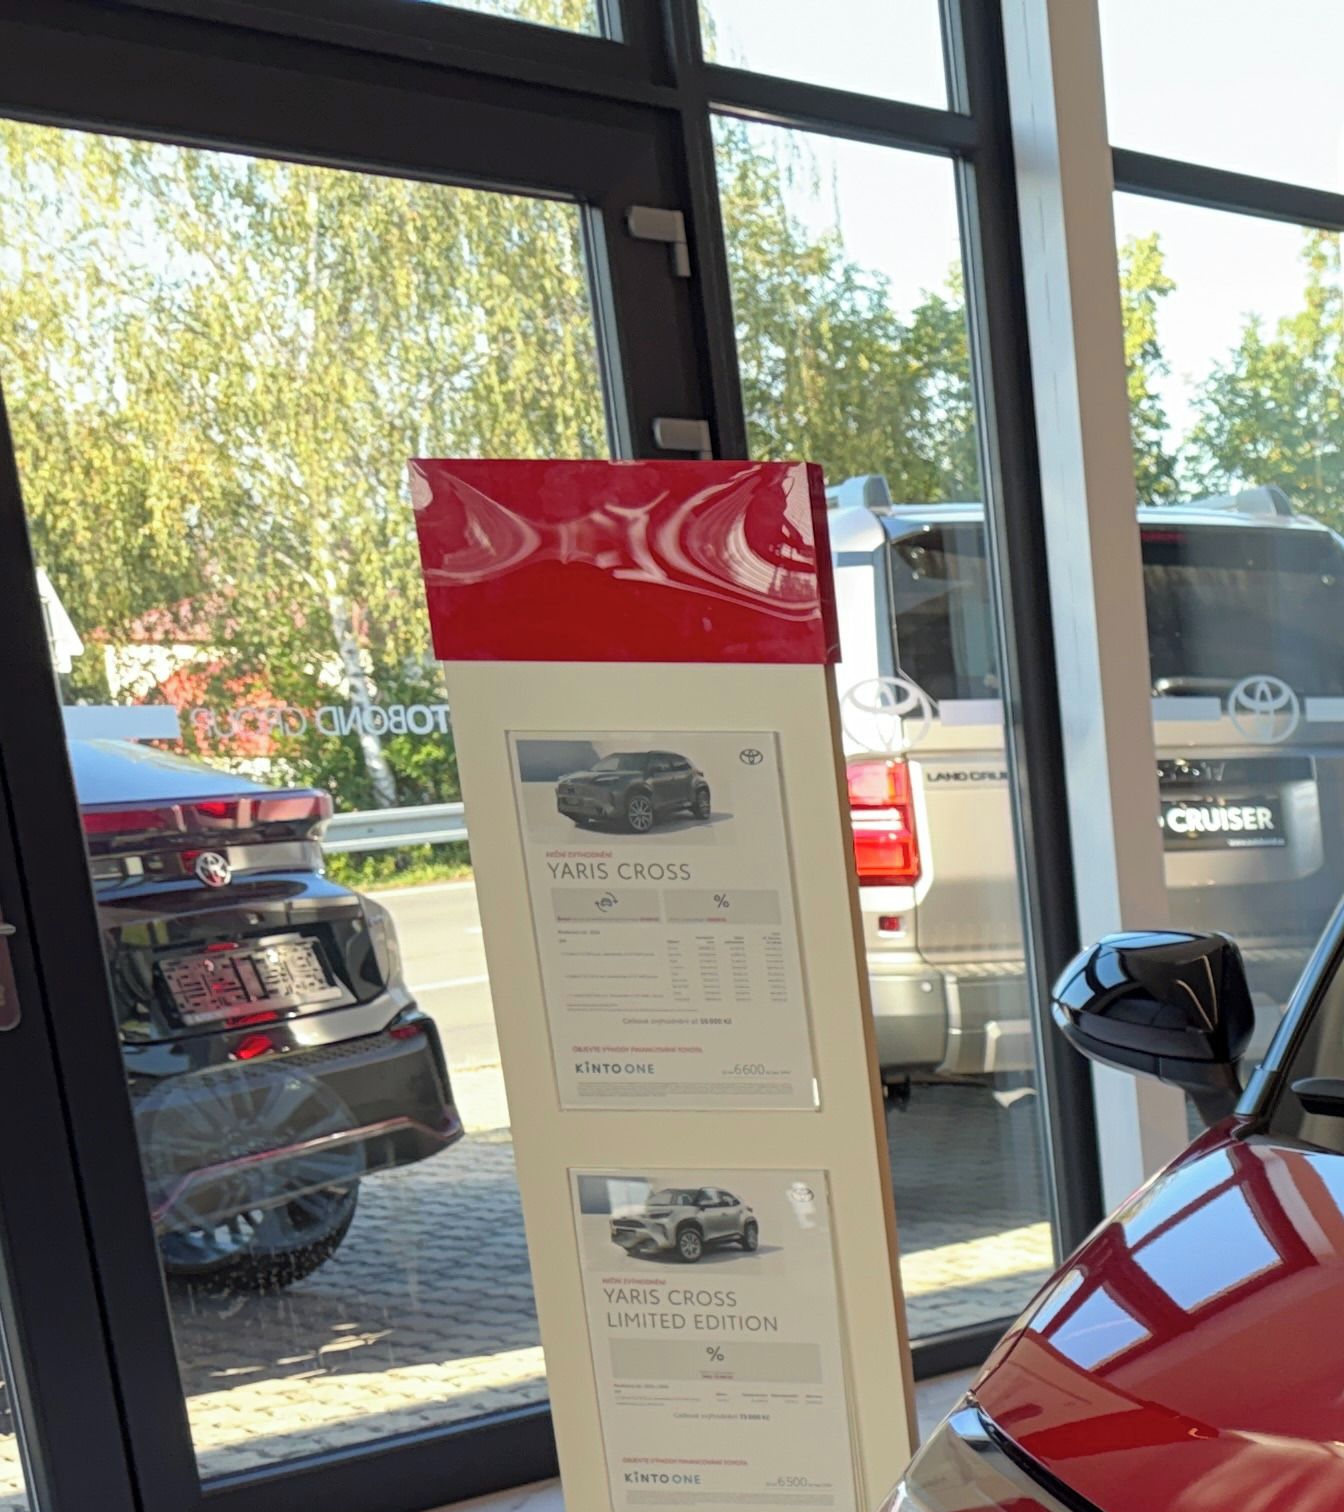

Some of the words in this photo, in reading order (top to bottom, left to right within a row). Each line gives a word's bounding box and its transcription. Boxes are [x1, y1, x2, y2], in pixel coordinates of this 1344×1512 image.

[1166, 806, 1275, 833] CRUISER
[547, 862, 609, 880] YARIS
[617, 863, 692, 881] CROSS
[624, 1063, 655, 1074] ONE
[603, 1287, 661, 1305] YARIS
[667, 1289, 737, 1307] CROSS
[607, 1311, 686, 1330] LIMITED
[694, 1313, 778, 1332] EDITION
[671, 1474, 702, 1485] ONE
